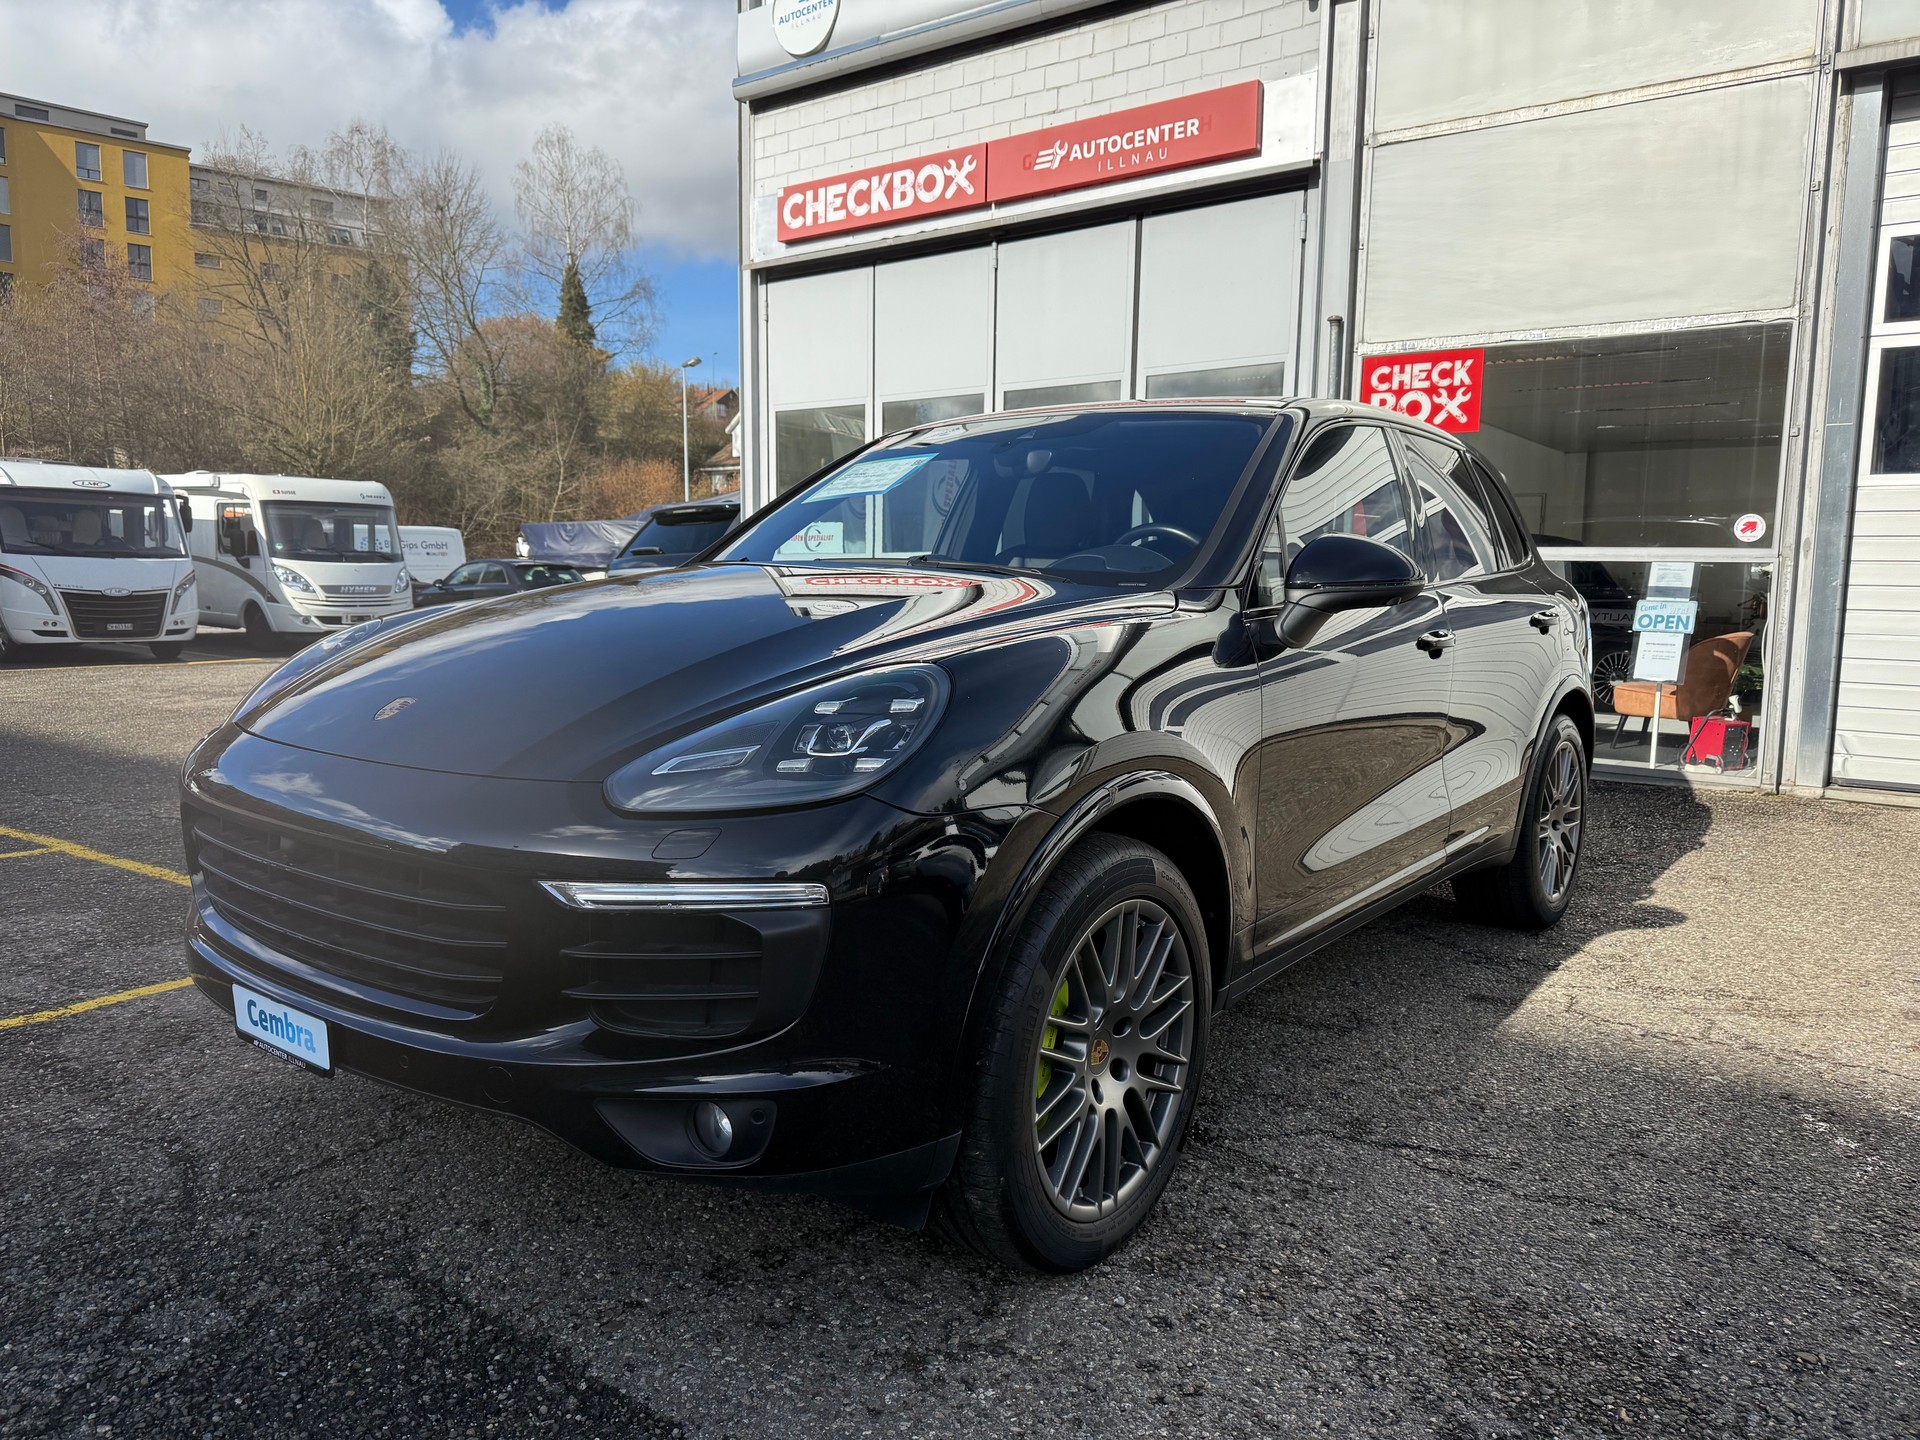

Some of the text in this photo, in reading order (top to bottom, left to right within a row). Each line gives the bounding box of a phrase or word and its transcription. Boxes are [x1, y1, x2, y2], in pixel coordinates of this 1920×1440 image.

[1069, 118, 1200, 162] AUTOCENTER
[1098, 148, 1168, 172] ILLNAU
[783, 154, 977, 229] CHECKBOX
[1370, 358, 1475, 392] CHECK
[420, 540, 449, 550] GmbH
[1638, 614, 1690, 630] OPEN
[247, 999, 316, 1054] Cembra
[259, 1040, 288, 1061] AUTOCENTER
